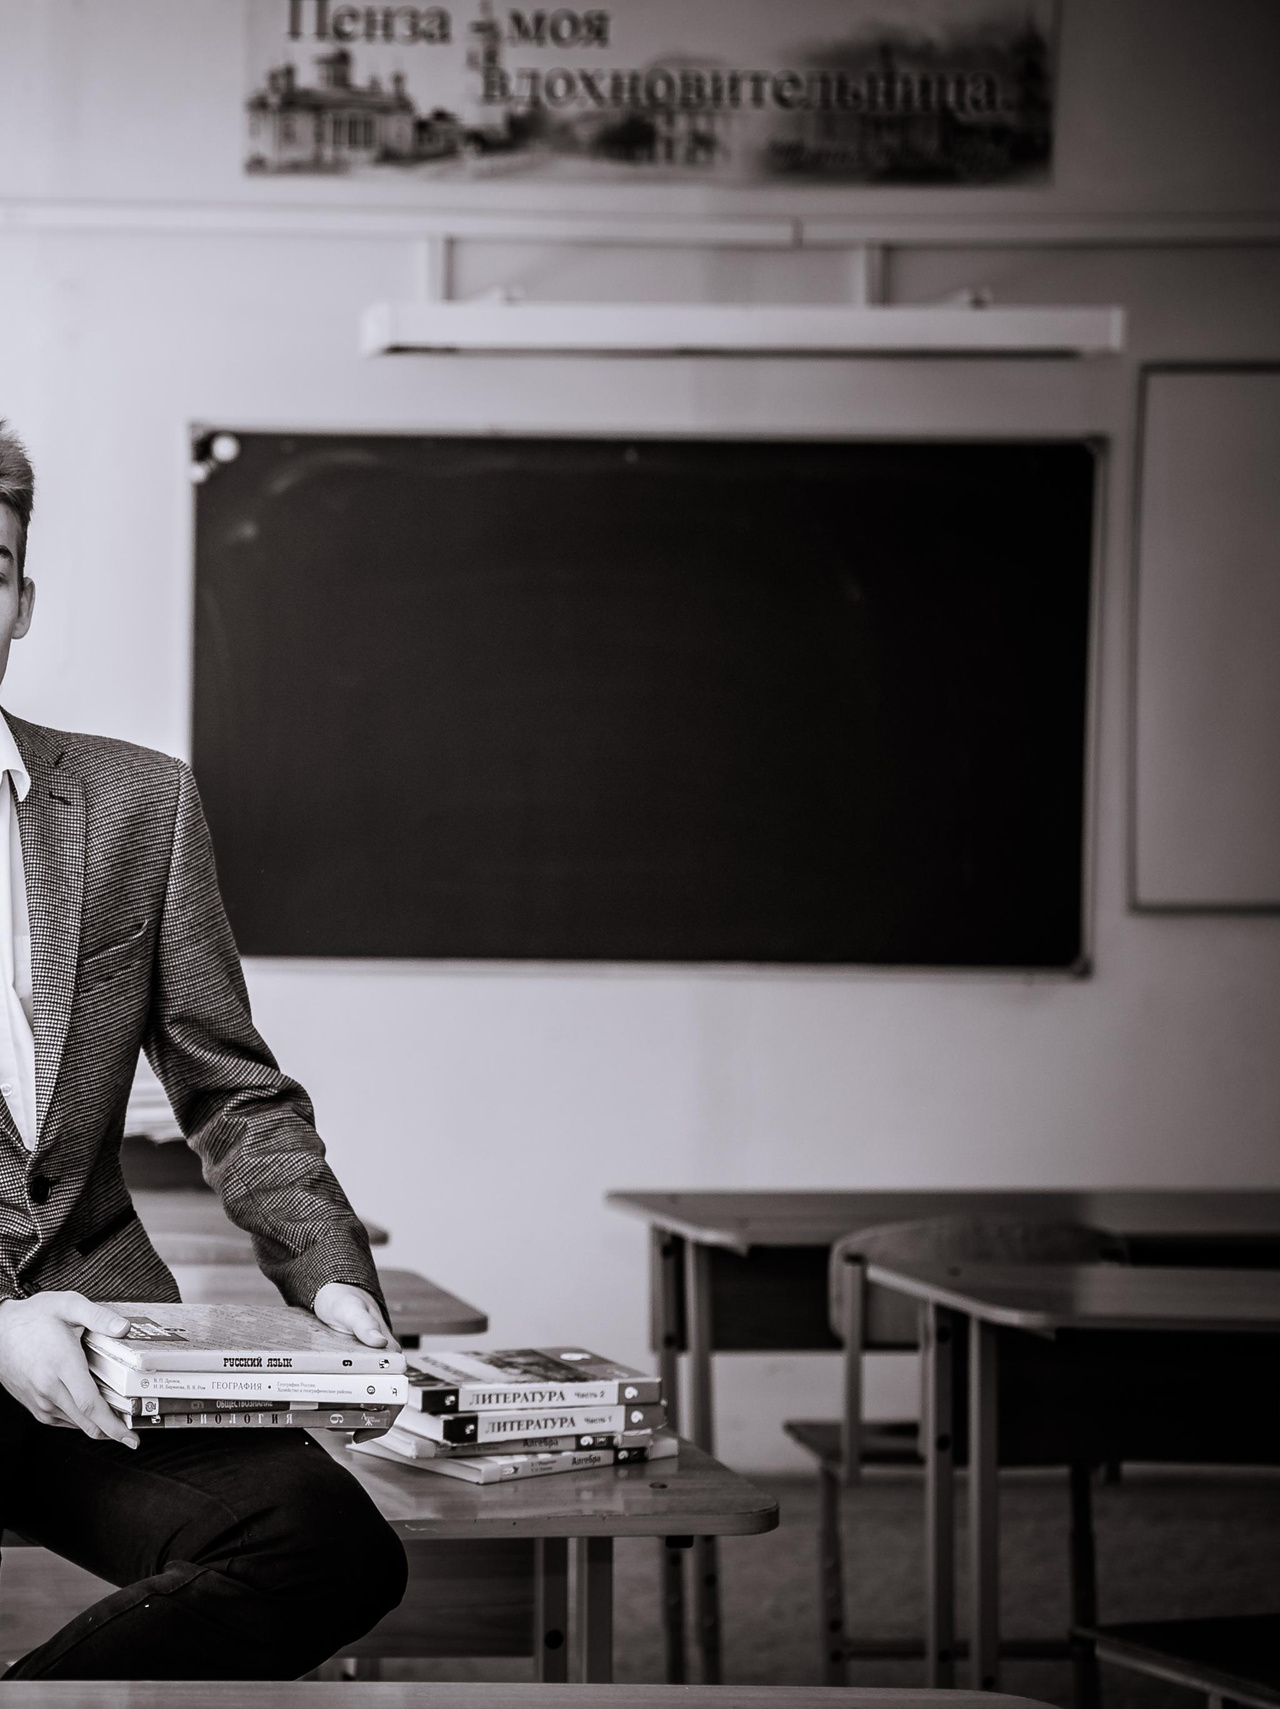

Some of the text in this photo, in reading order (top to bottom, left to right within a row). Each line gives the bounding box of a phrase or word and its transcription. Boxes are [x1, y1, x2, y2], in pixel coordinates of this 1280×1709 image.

[288, 0, 452, 45] Пенза
[508, 7, 611, 48] моя
[223, 1357, 293, 1368] РУССКИЙ ЯЗЫК
[211, 1381, 262, 1390] ГЕОГРАФИЯ
[469, 1389, 565, 1405] ЛИТЕРАТУРА
[186, 1413, 293, 1424] БИОЛОГИЯ
[485, 1416, 576, 1434] ЛИТЕРАТУРА
